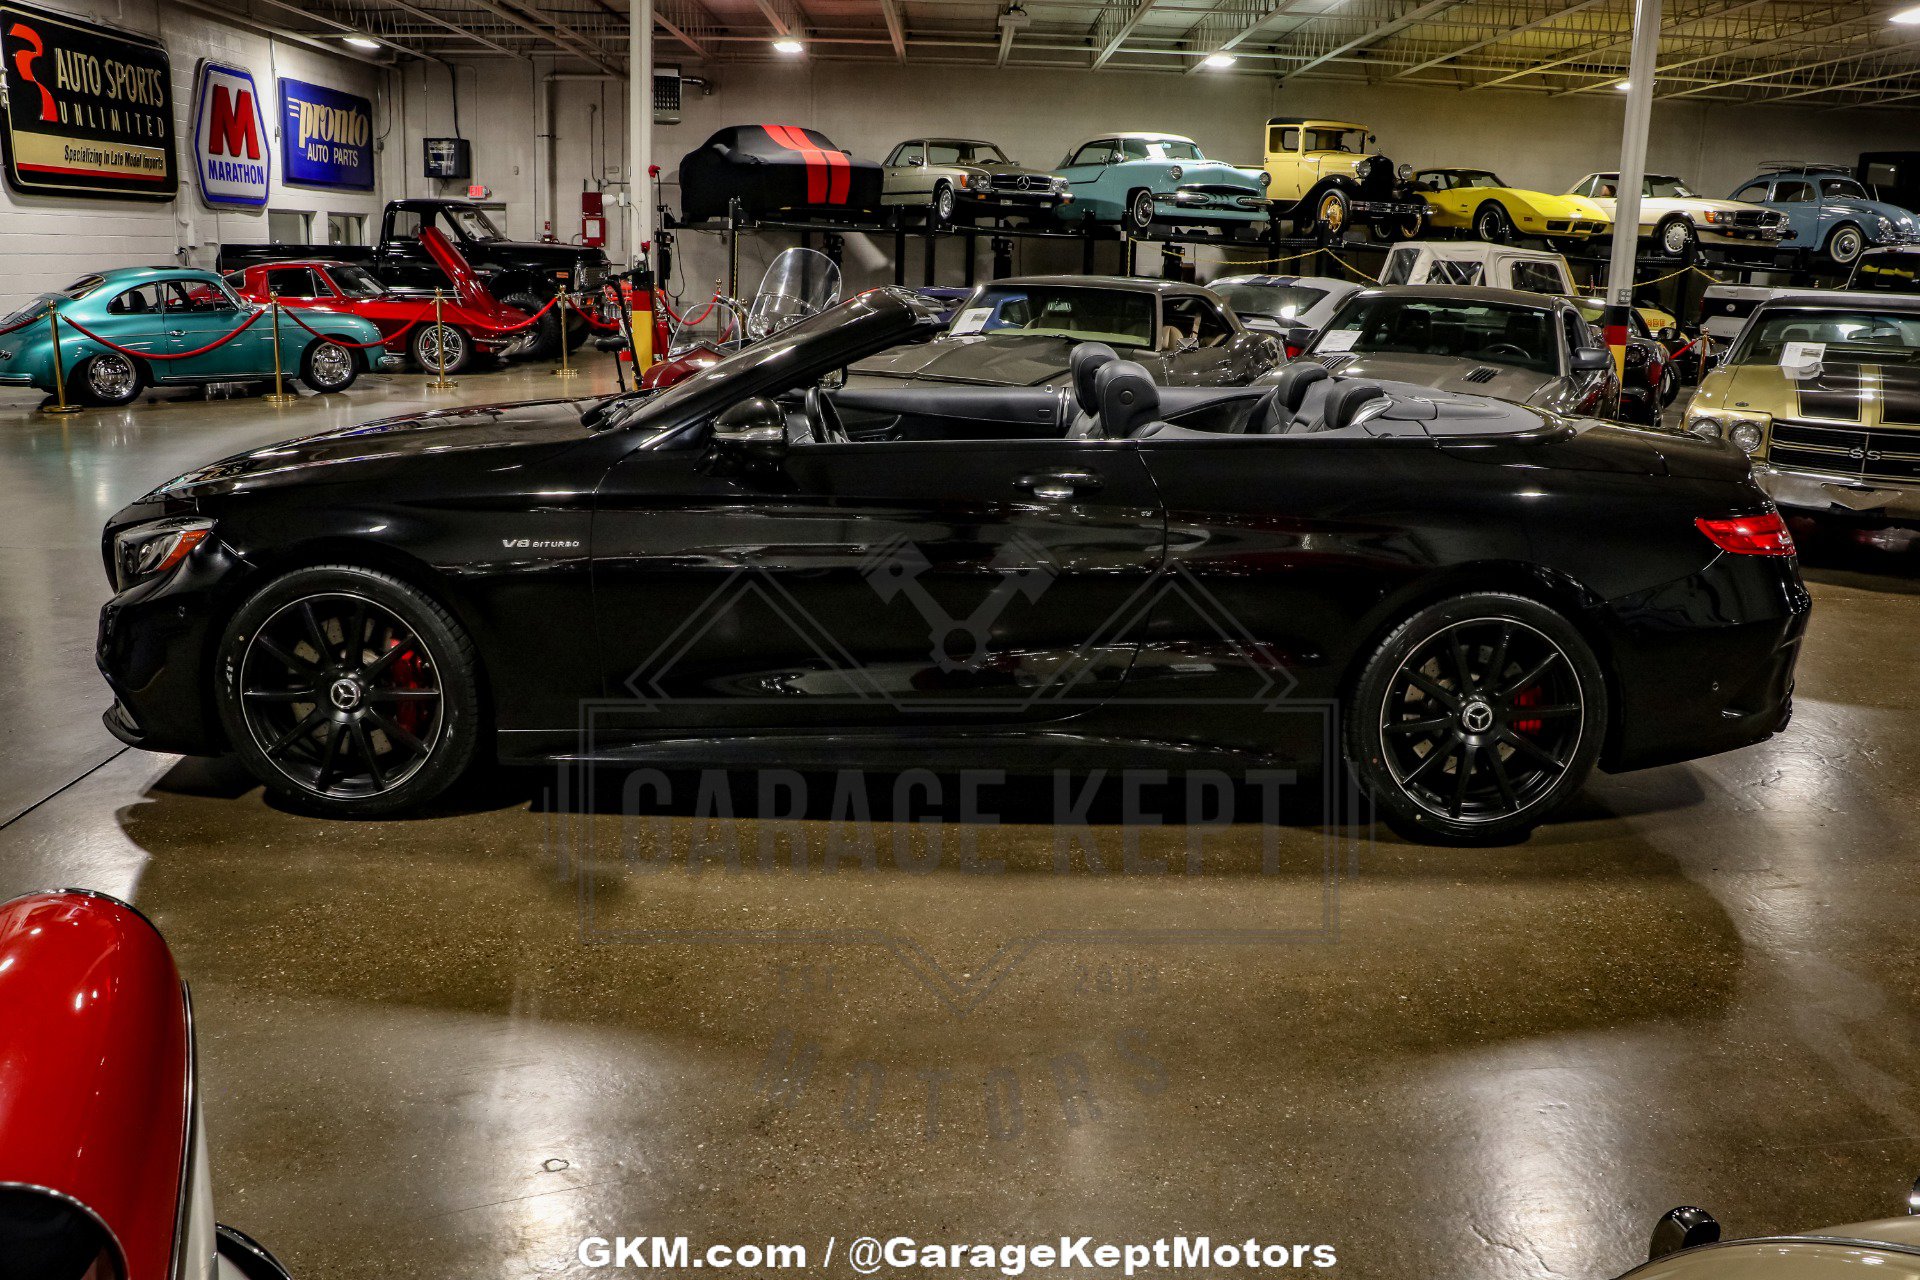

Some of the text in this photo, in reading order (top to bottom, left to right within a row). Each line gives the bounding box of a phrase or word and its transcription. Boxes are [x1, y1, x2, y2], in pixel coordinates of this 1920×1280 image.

[55, 48, 164, 108] AUTO SPORTS
[59, 101, 164, 138] UNLIMITED
[209, 84, 260, 160] M
[297, 100, 369, 149] pronto
[64, 144, 163, 171] Specializing In Late Model Imports
[307, 142, 359, 168] AUTO PARTS
[208, 159, 264, 185] MARATHON
[1849, 447, 1881, 461] SS
[502, 539, 580, 548] V8 BITURBO
